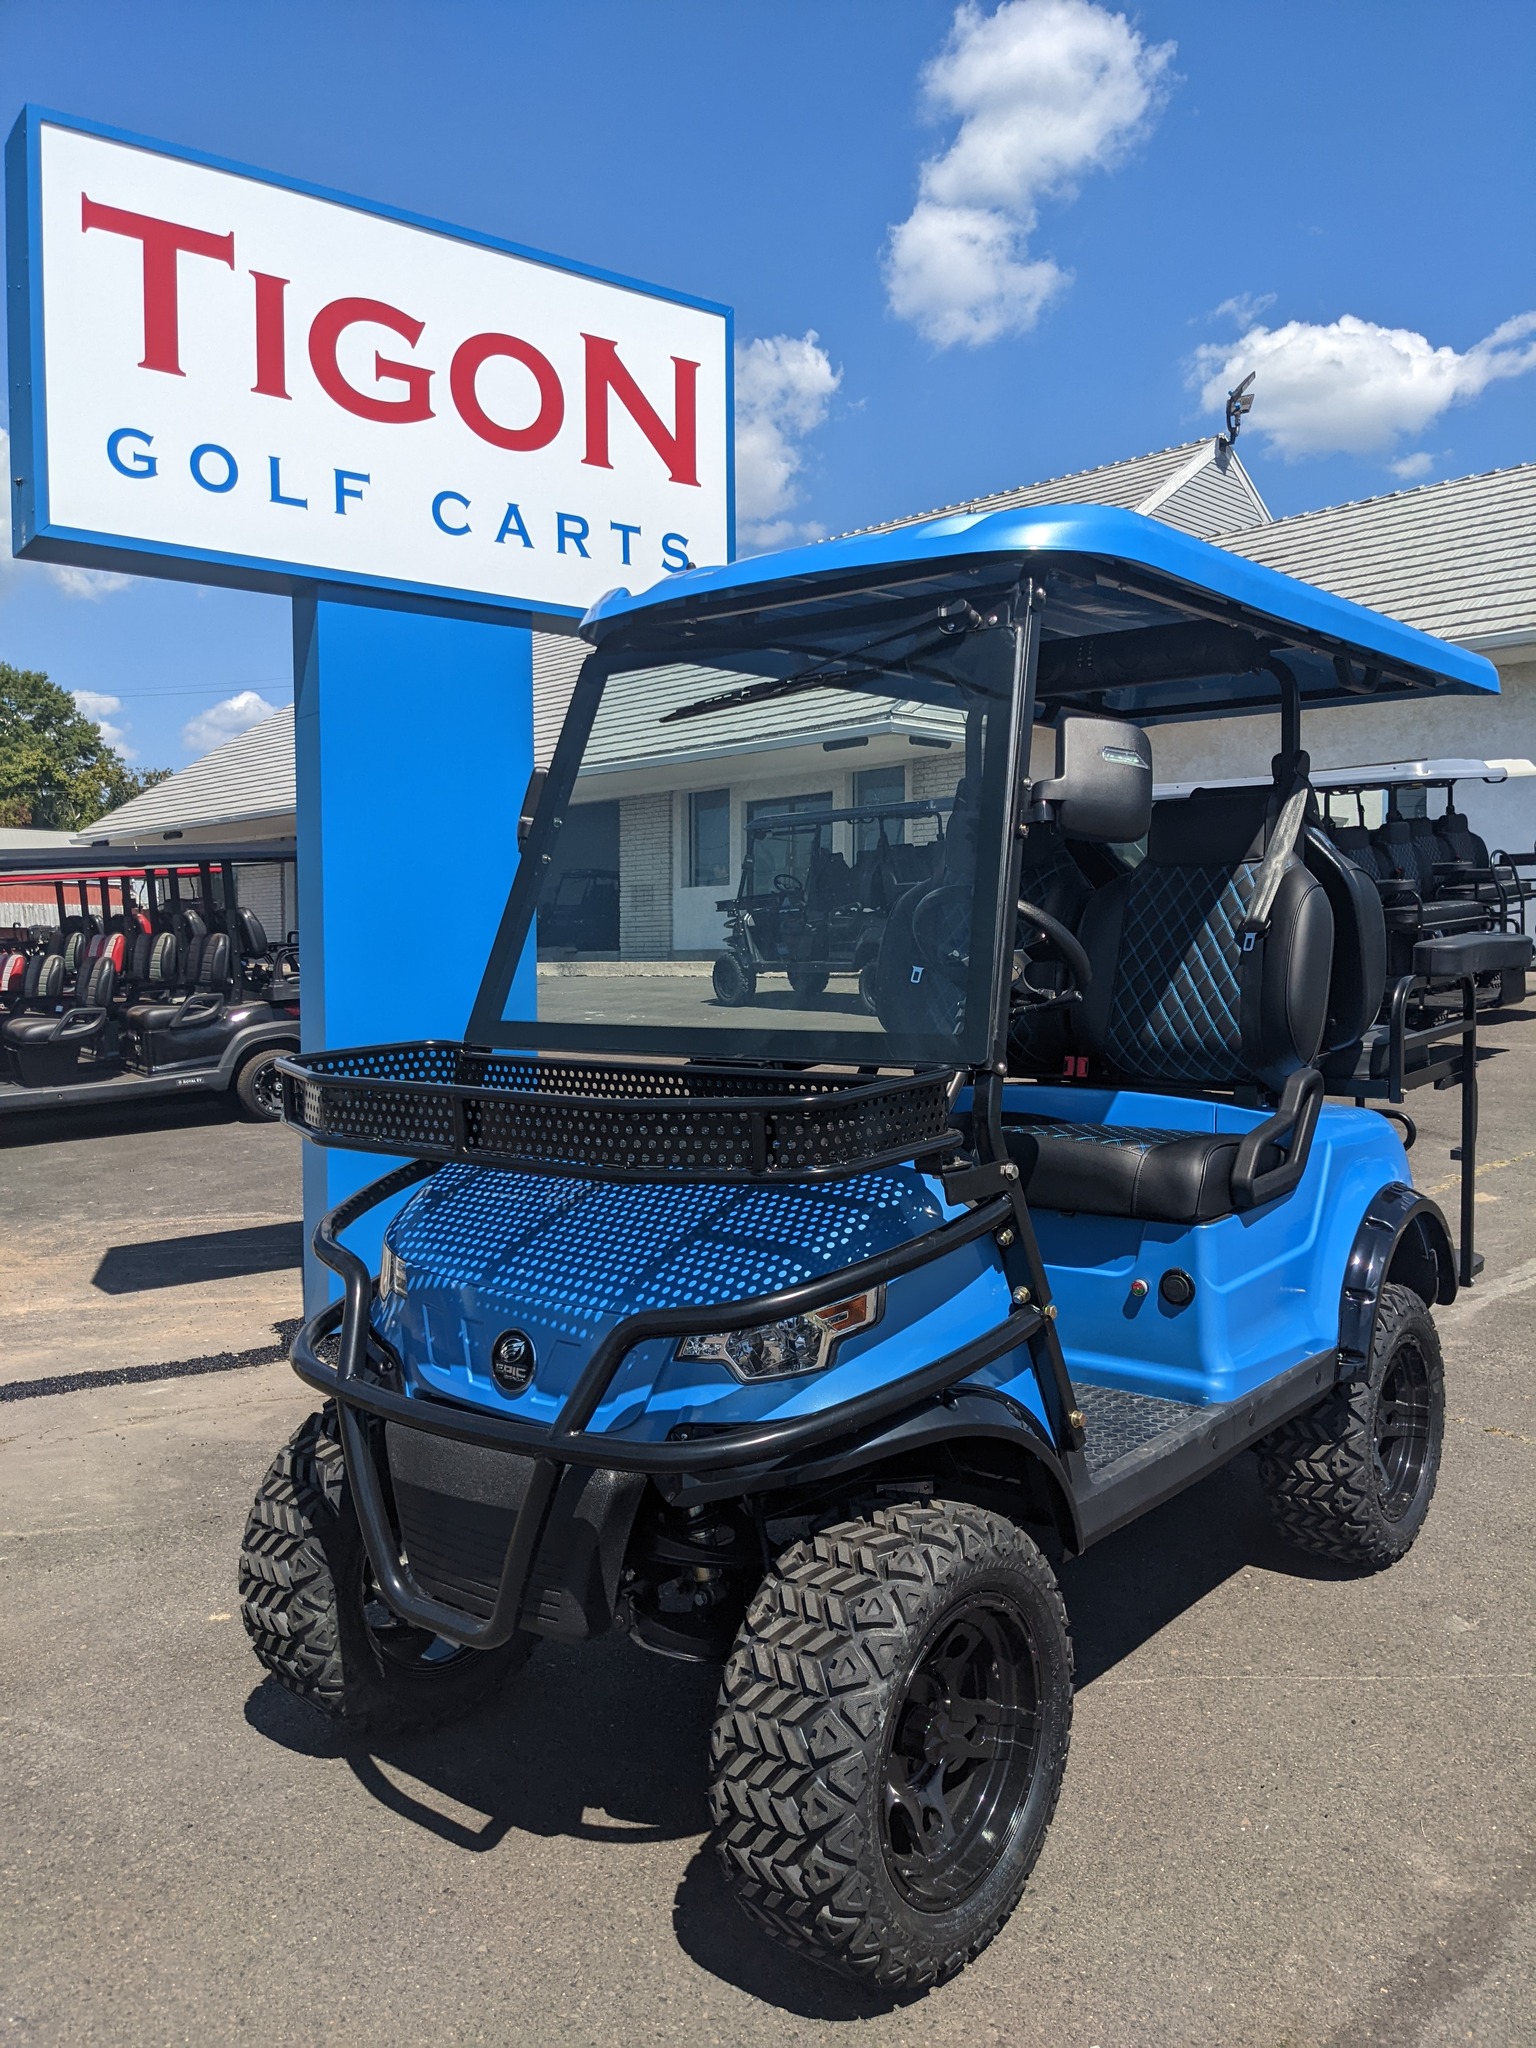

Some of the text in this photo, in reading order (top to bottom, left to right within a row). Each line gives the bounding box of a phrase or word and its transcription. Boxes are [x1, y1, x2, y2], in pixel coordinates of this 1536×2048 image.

[82, 192, 701, 488] TIGON
[106, 427, 690, 574] GOLF CARTS
[496, 1363, 526, 1378] EPIC
